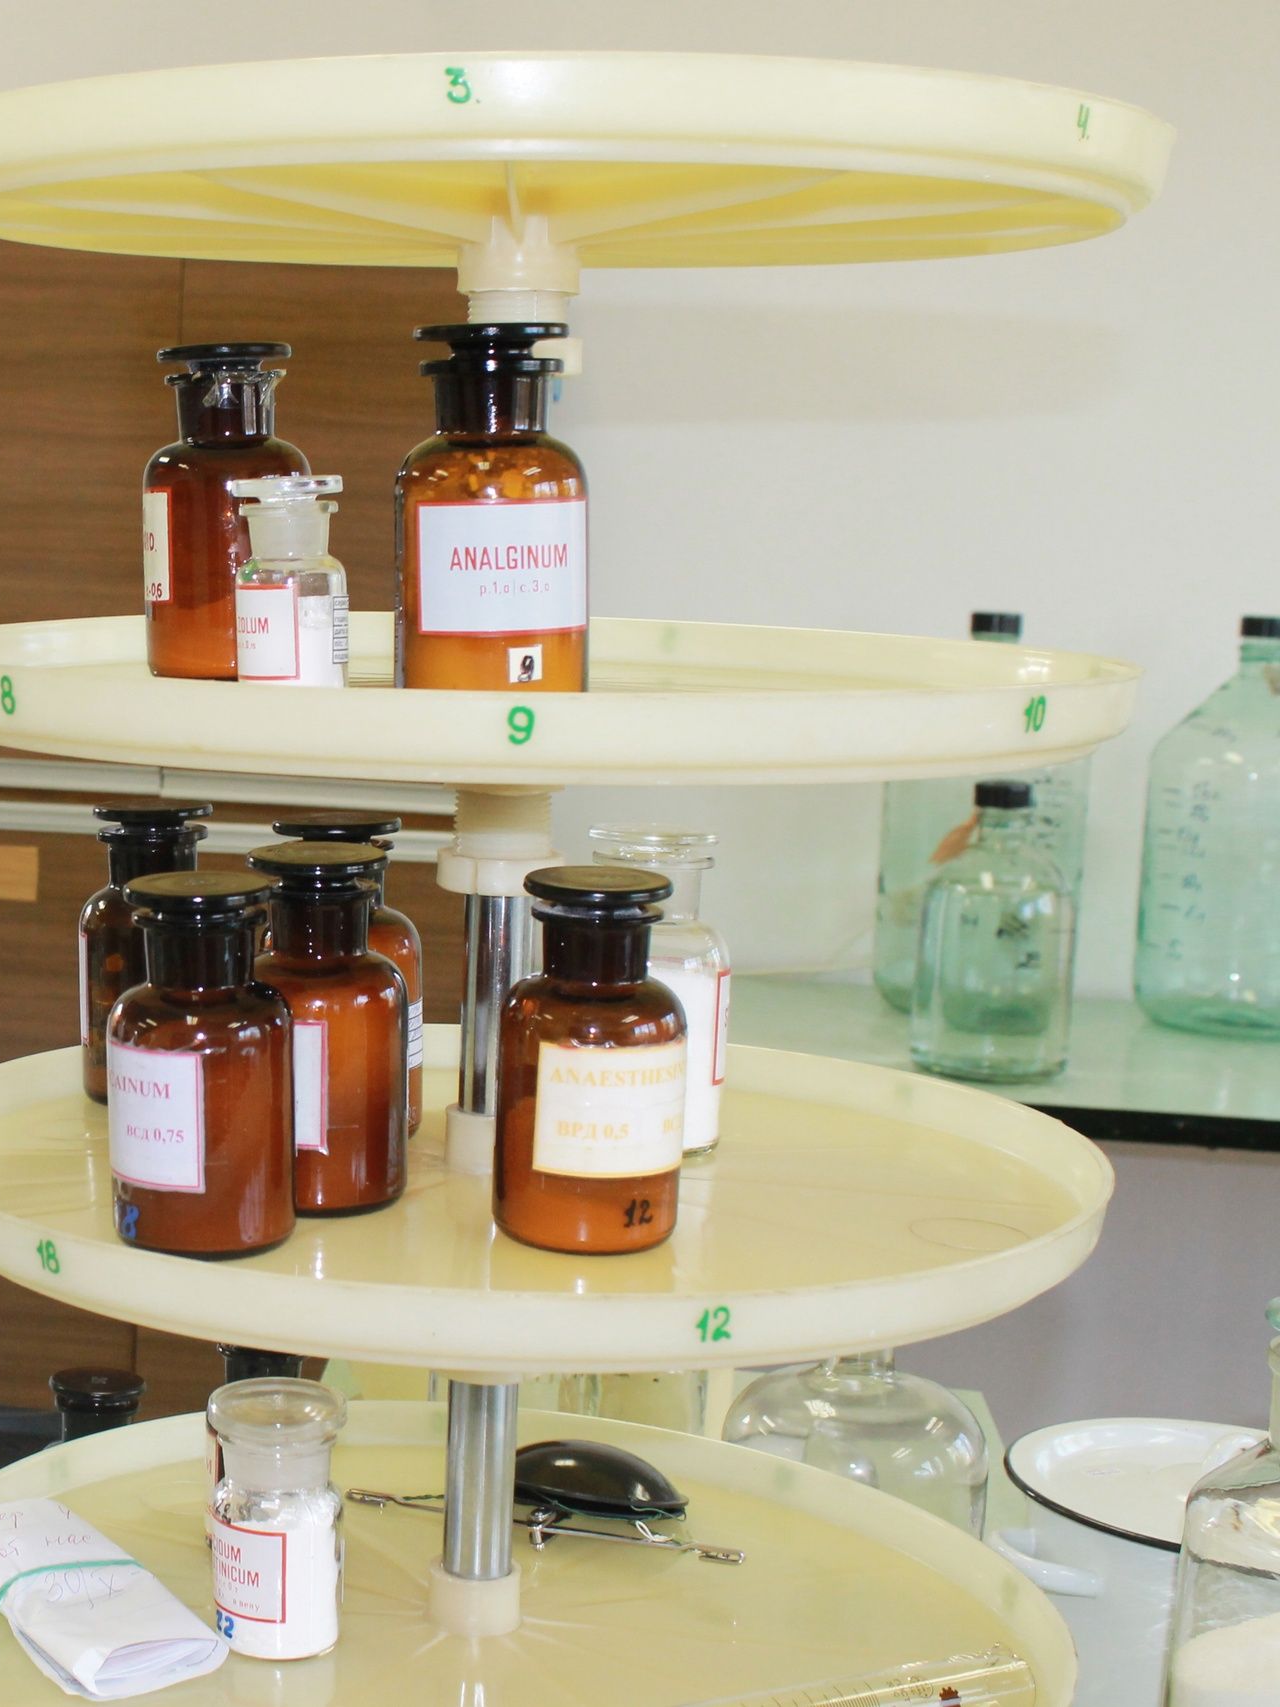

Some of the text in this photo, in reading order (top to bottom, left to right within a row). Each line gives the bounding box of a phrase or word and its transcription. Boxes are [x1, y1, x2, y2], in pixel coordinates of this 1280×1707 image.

[450, 543, 568, 571] ANALGINUM
[0, 675, 16, 716] 8
[507, 705, 536, 746] 9
[1023, 695, 1047, 734] 10
[153, 1129, 185, 1144] 0,75
[623, 1198, 654, 1229] 12
[36, 1239, 61, 1275] 18
[695, 1305, 732, 1343] 12
